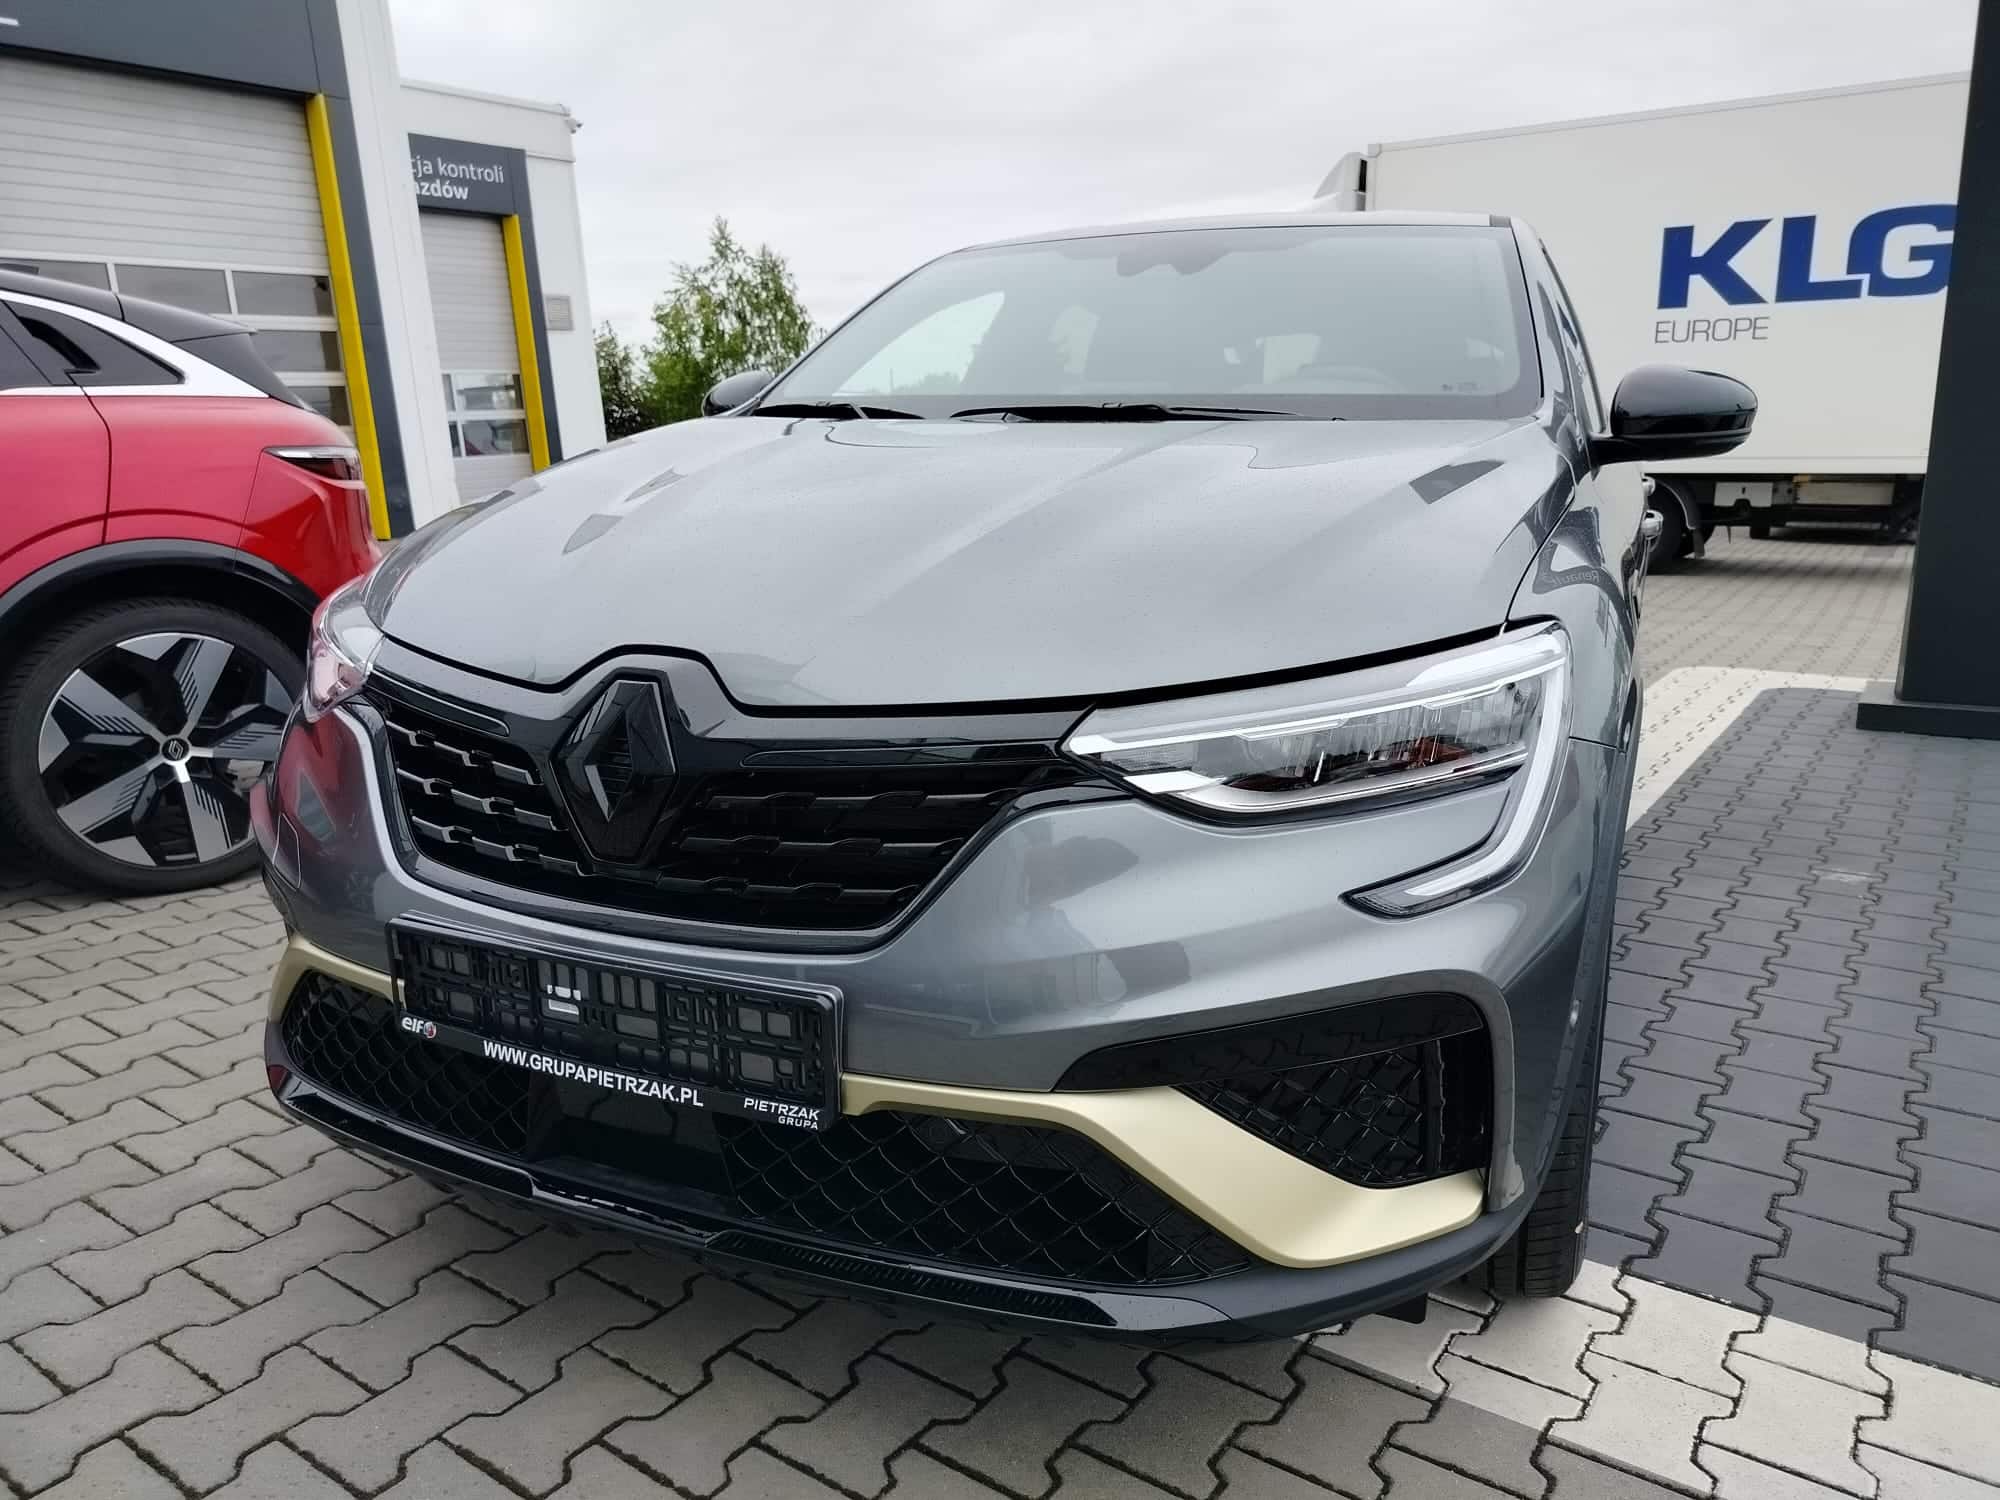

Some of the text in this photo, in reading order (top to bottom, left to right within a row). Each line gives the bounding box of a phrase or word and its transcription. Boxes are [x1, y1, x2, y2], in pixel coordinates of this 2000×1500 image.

[437, 157, 504, 184] kontroli
[1657, 203, 1958, 309] KLG
[1654, 316, 1770, 344] EUROPE
[401, 1016, 424, 1033] elf
[483, 1040, 704, 1107] WWW.GRUPAPIETRZAK.PL
[743, 1097, 820, 1121] PIETRZAK
[777, 1115, 819, 1130] GRUPA
